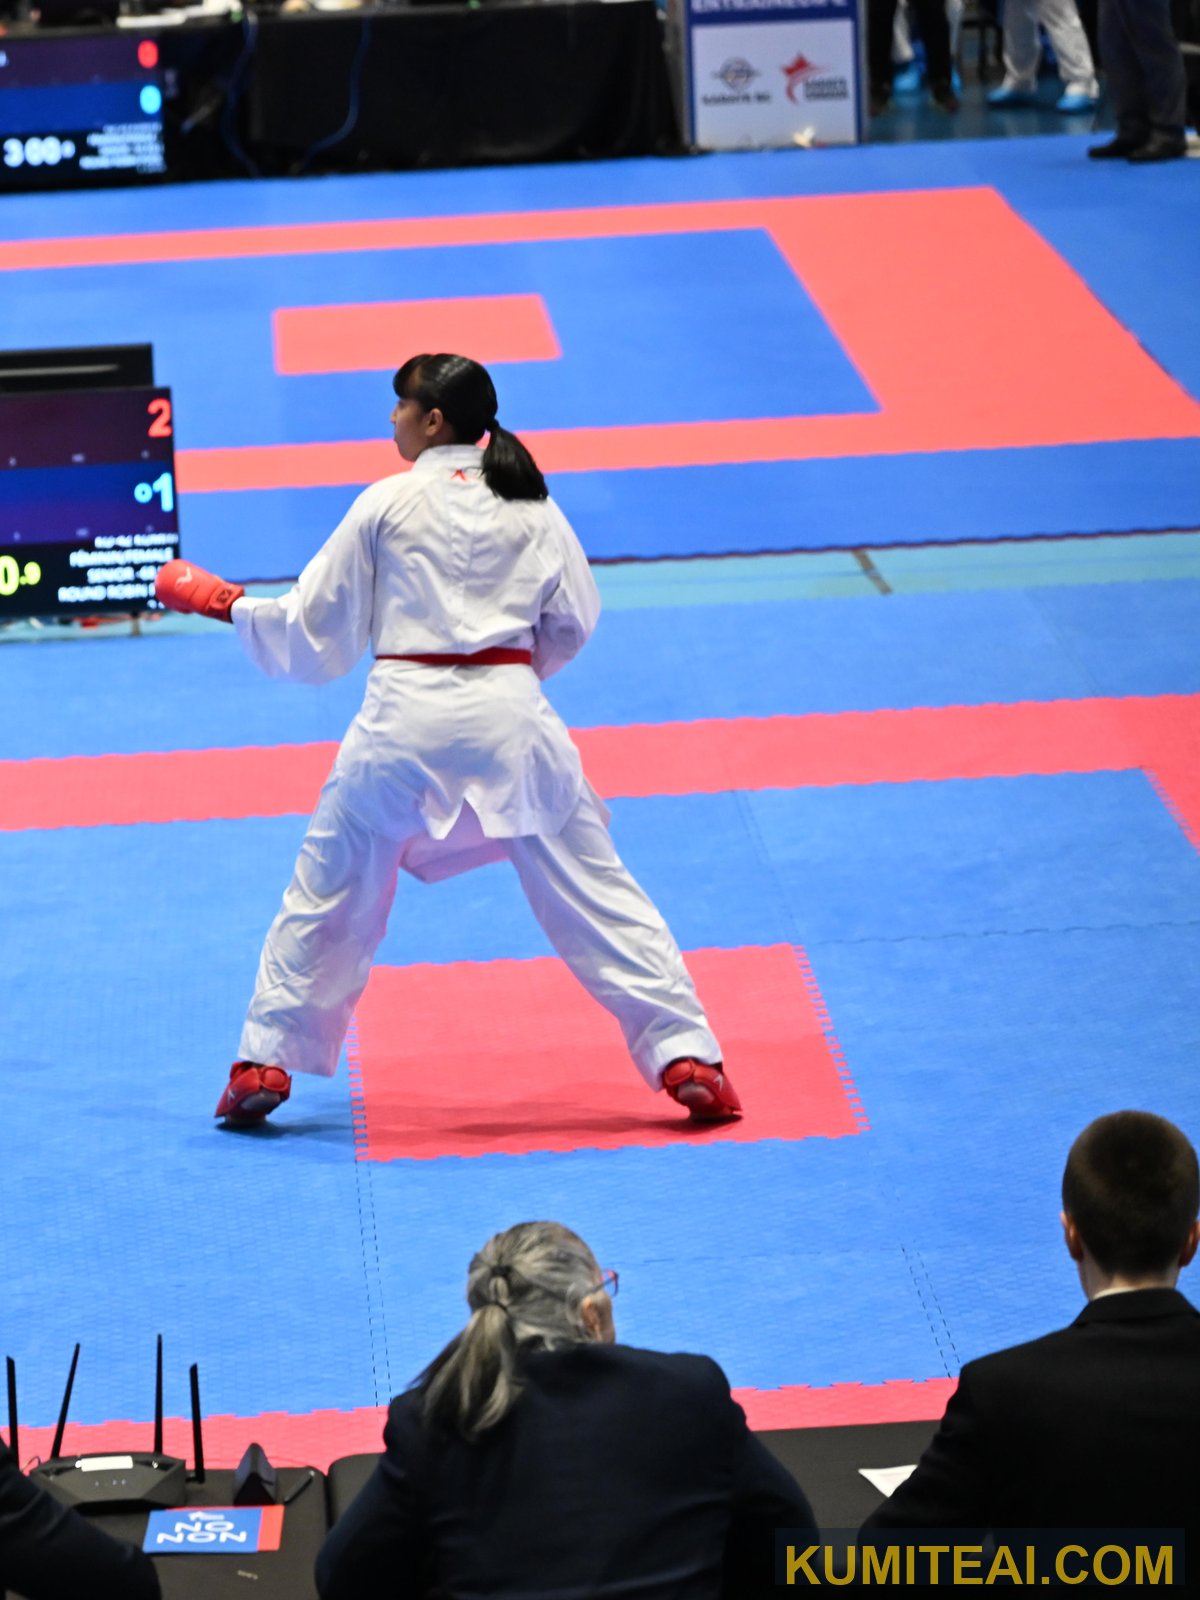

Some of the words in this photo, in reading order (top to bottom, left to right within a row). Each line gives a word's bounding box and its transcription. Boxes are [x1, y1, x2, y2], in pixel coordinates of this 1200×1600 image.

[147, 398, 173, 438] 2
[152, 472, 174, 513] 1
[58, 585, 107, 602] ROUND
[106, 583, 148, 600] ROBIN
[174, 1520, 235, 1533] NO
[156, 1531, 247, 1544] NON
